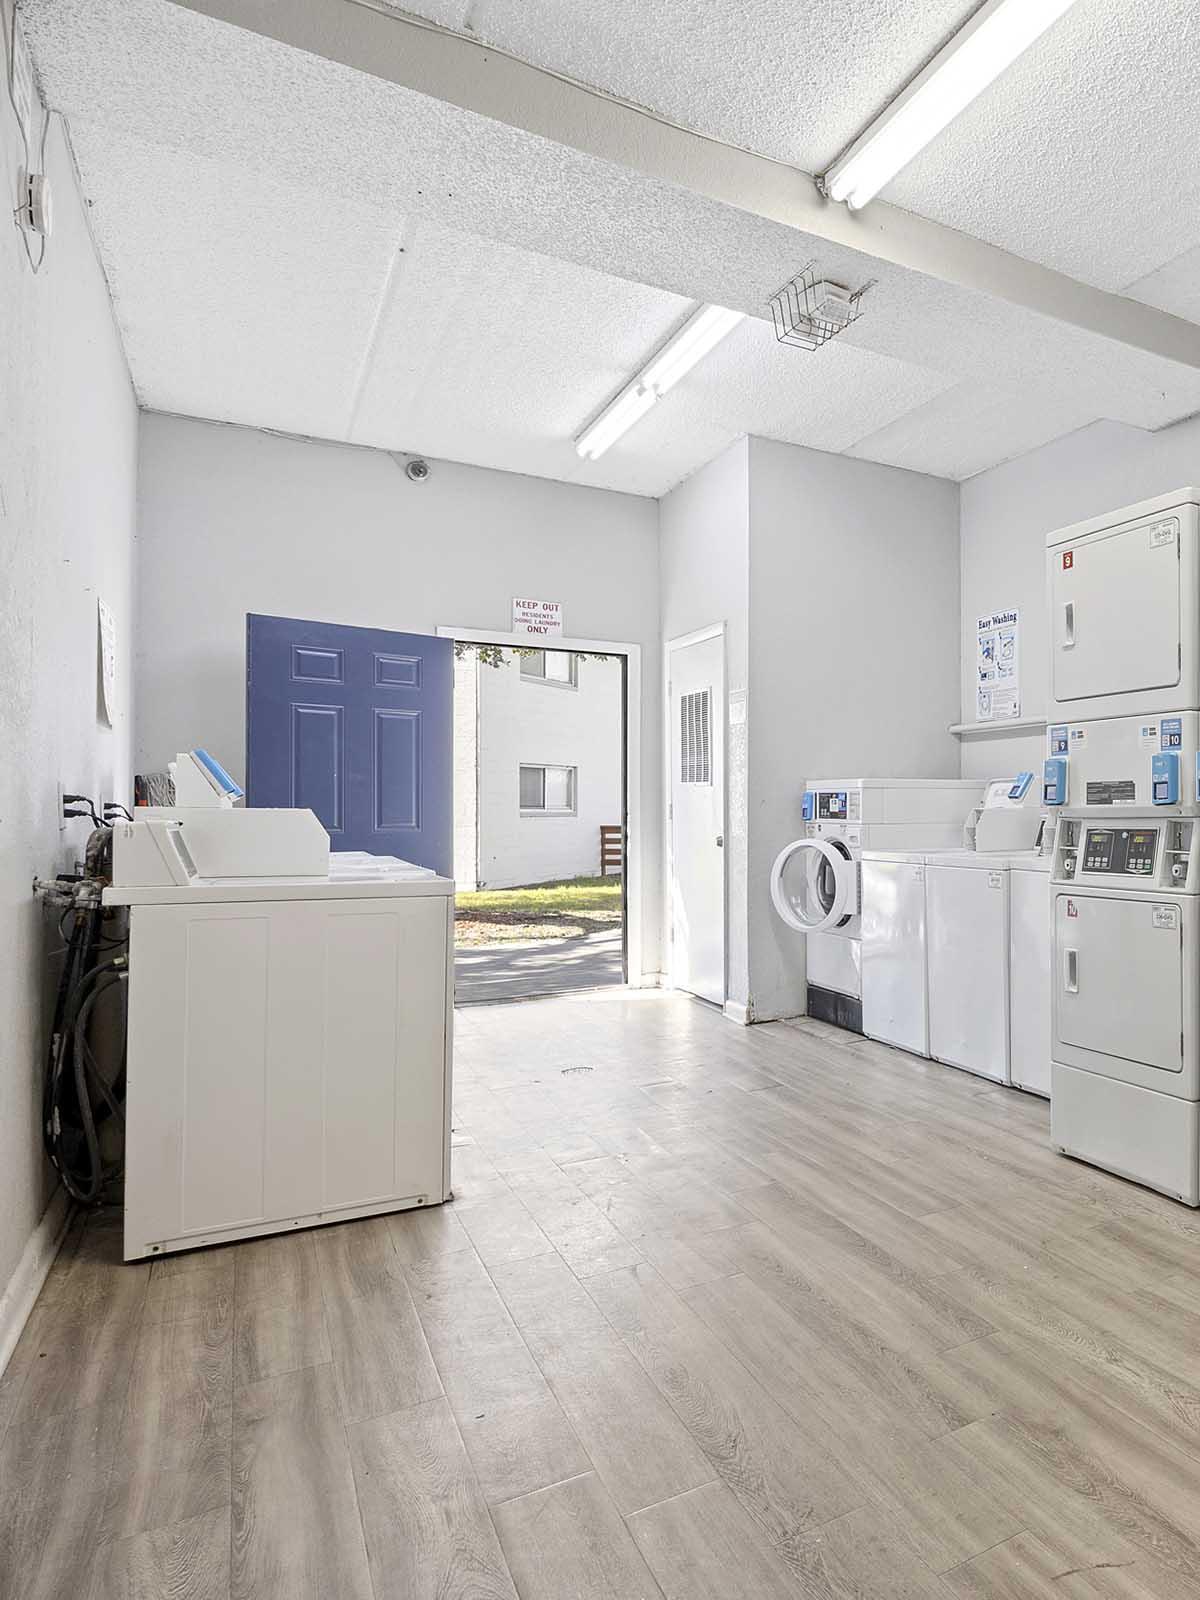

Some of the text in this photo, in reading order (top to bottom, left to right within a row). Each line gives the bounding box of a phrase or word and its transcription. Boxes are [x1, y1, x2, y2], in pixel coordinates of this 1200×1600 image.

[1065, 556, 1071, 567] 9
[515, 600, 560, 612] KEEP OUT
[521, 611, 554, 620] RESIDENTS
[534, 619, 561, 627] LAUNDRY
[978, 613, 1017, 630] Easy Washing
[527, 625, 549, 635] ONLY
[1171, 736, 1179, 745] 10
[1060, 742, 1066, 751] 9
